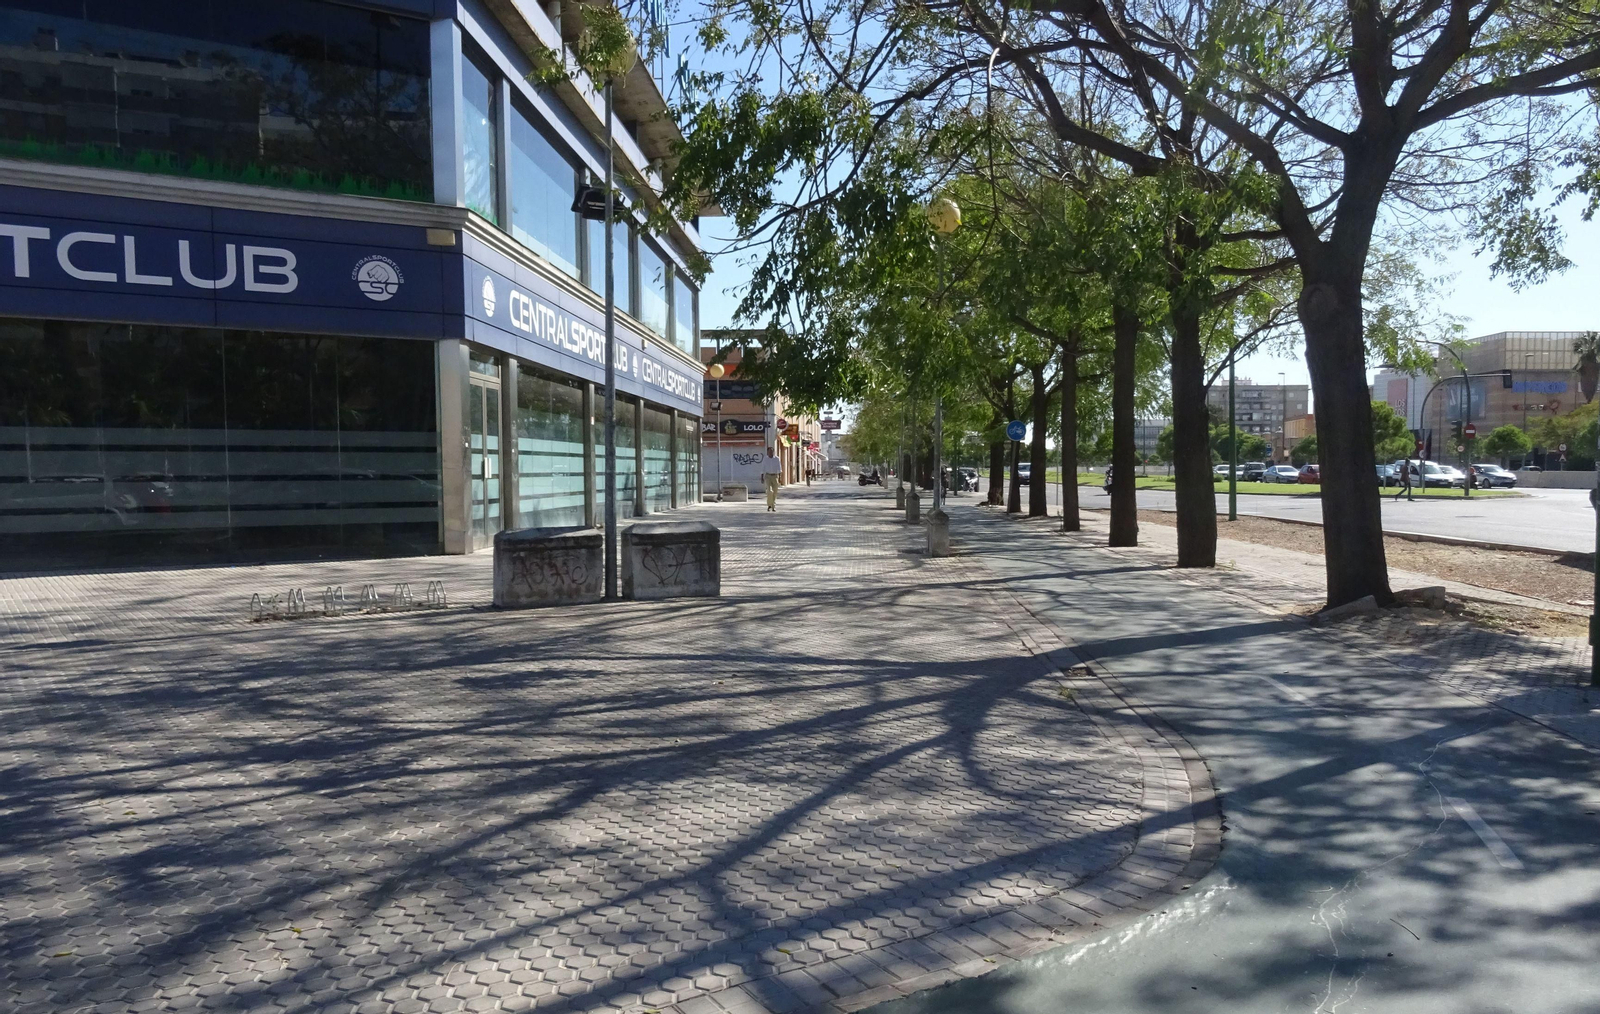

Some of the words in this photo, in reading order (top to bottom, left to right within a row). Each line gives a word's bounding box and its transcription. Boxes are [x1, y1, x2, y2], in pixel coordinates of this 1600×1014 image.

[351, 254, 405, 284] CENTRALSPORTCLUB
[509, 289, 628, 373] CENTRALSPORTUB
[642, 357, 696, 402] CENTRALSPORTCLUB
[702, 423, 716, 432] BAR
